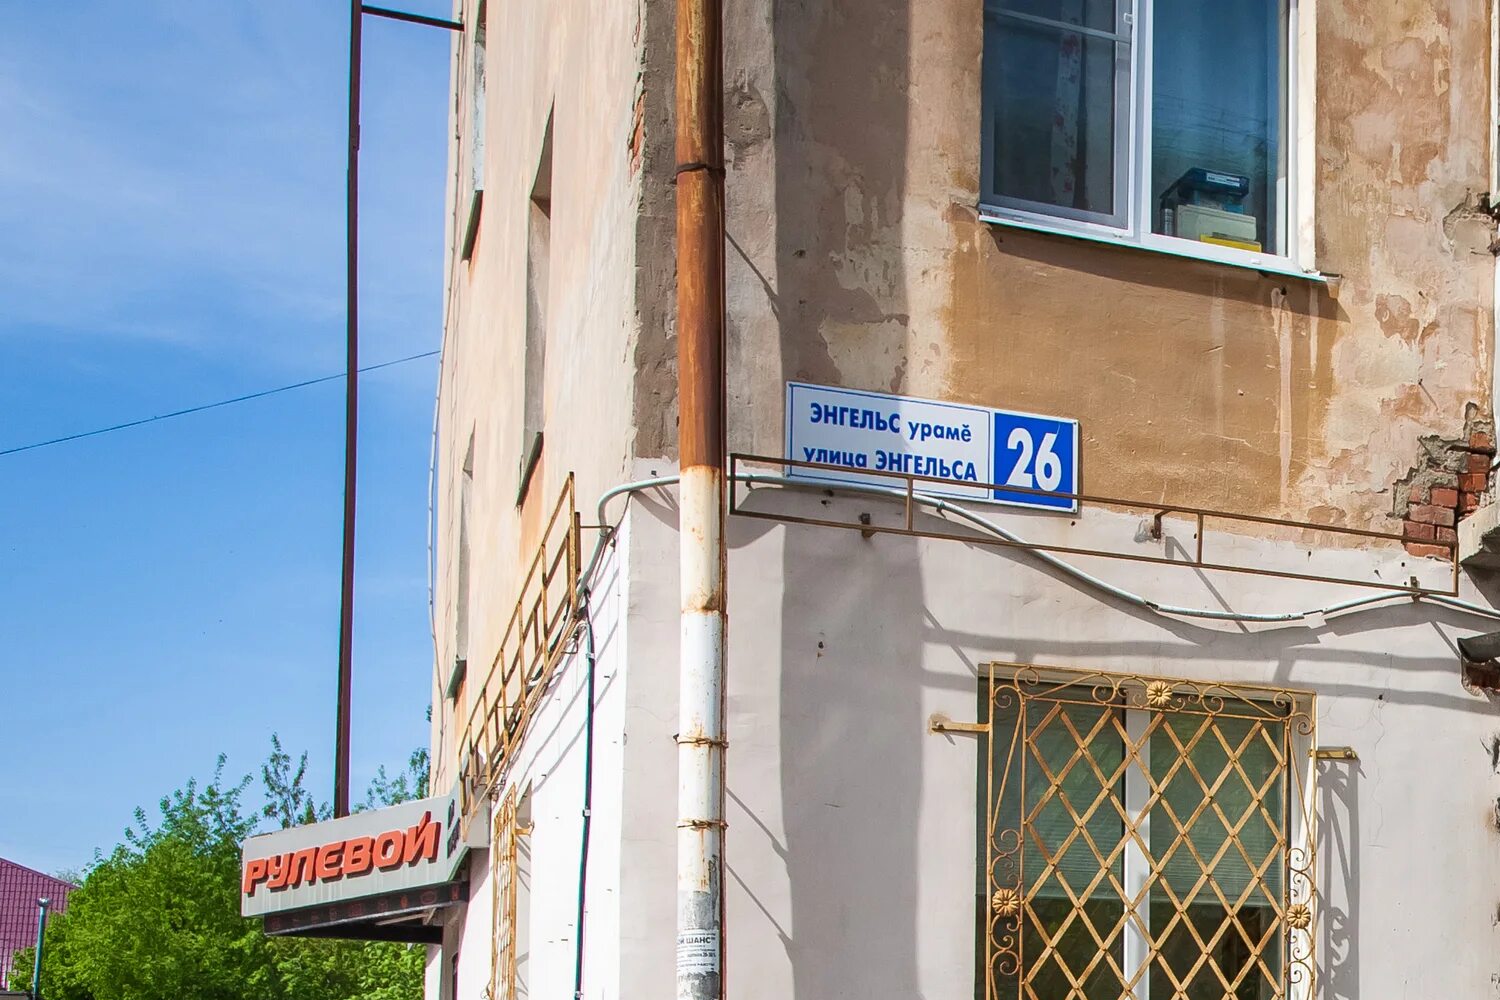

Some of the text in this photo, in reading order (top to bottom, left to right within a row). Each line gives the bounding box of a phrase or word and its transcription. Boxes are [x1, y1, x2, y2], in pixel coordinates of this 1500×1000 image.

[810, 402, 900, 433] ЭНГЕЛЬС
[803, 446, 978, 482] улица ЭНГЕЛЬСА
[1004, 427, 1062, 492] 26
[243, 811, 441, 896] РУЛЕВОЙ
